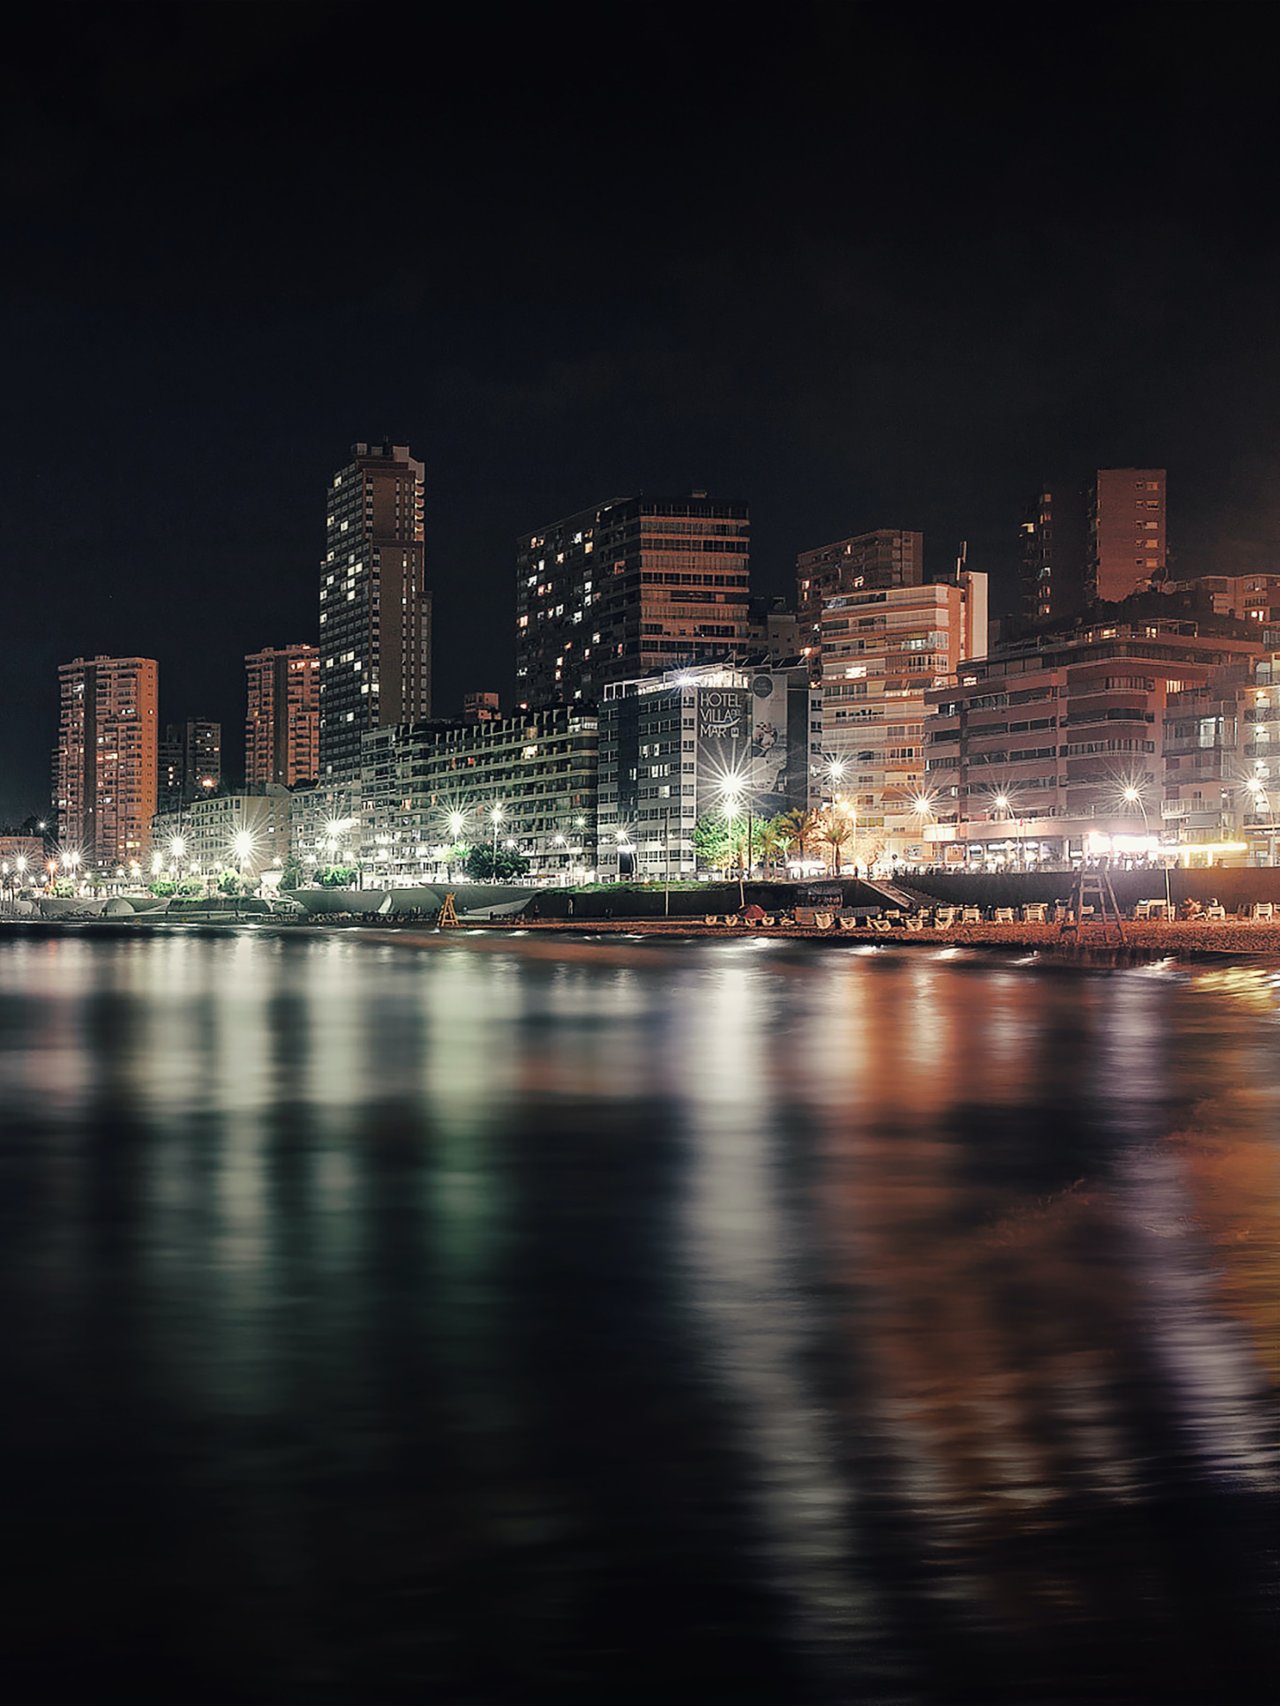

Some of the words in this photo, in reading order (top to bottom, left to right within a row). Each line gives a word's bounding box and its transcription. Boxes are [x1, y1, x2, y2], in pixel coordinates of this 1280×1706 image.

[700, 692, 741, 707] HOTEL
[700, 709, 732, 722] VILLA
[700, 724, 726, 738] MAR
